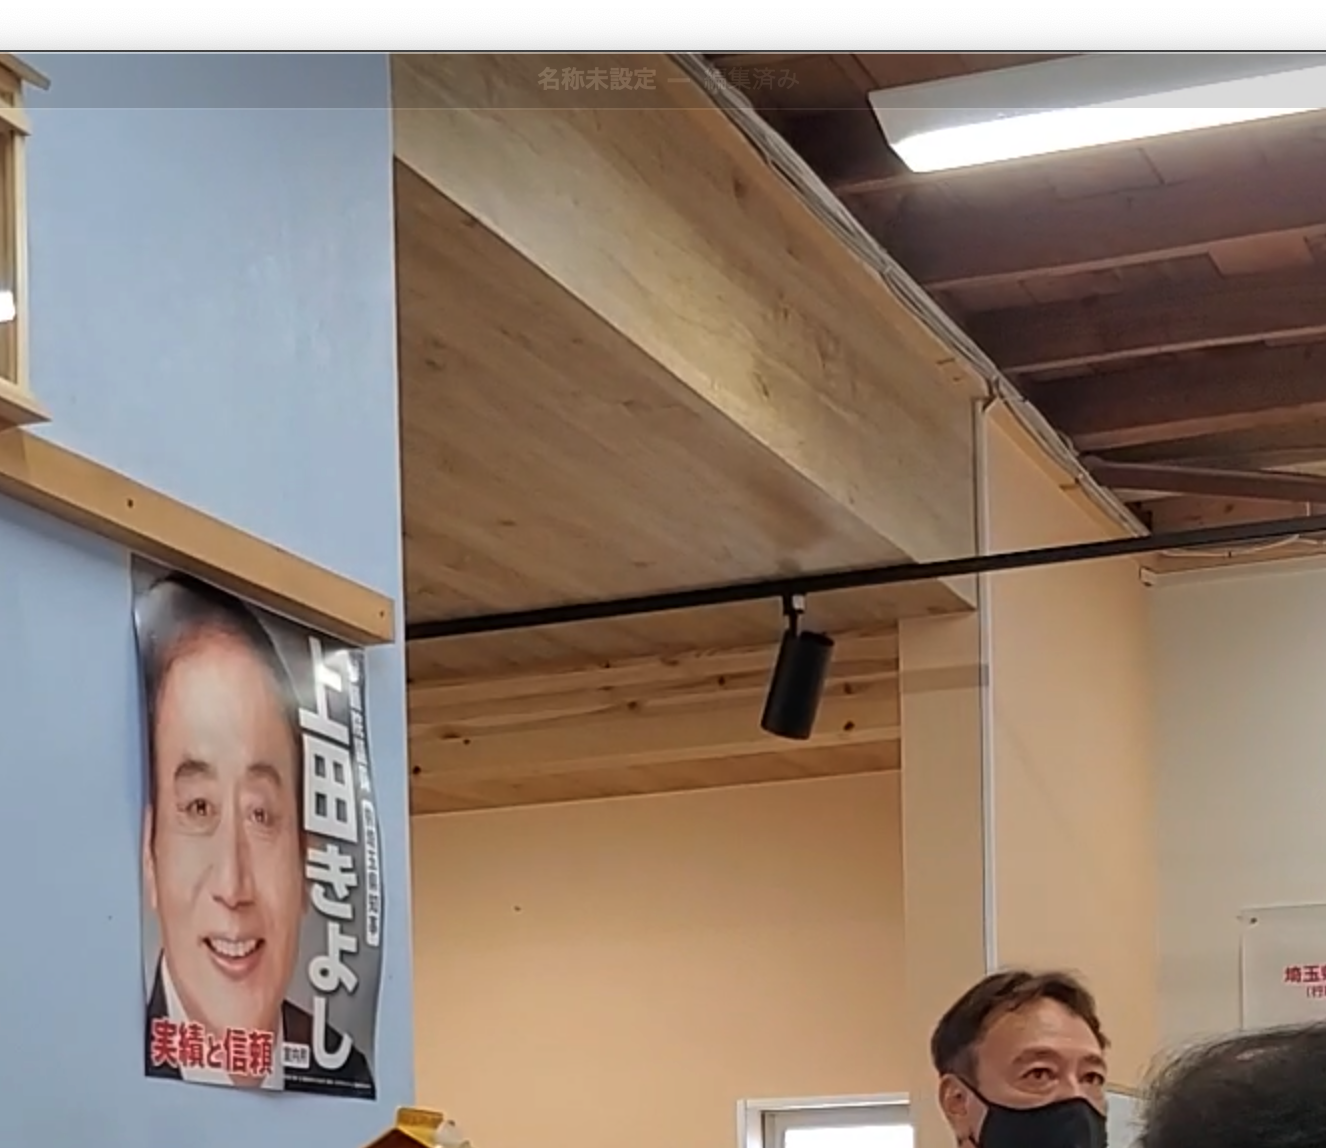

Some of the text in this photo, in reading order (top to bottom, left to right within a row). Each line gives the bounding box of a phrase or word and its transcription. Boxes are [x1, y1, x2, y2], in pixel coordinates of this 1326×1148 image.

[298, 637, 360, 1071] 上田きよし
[152, 1018, 274, 1076] 実績と信頼
